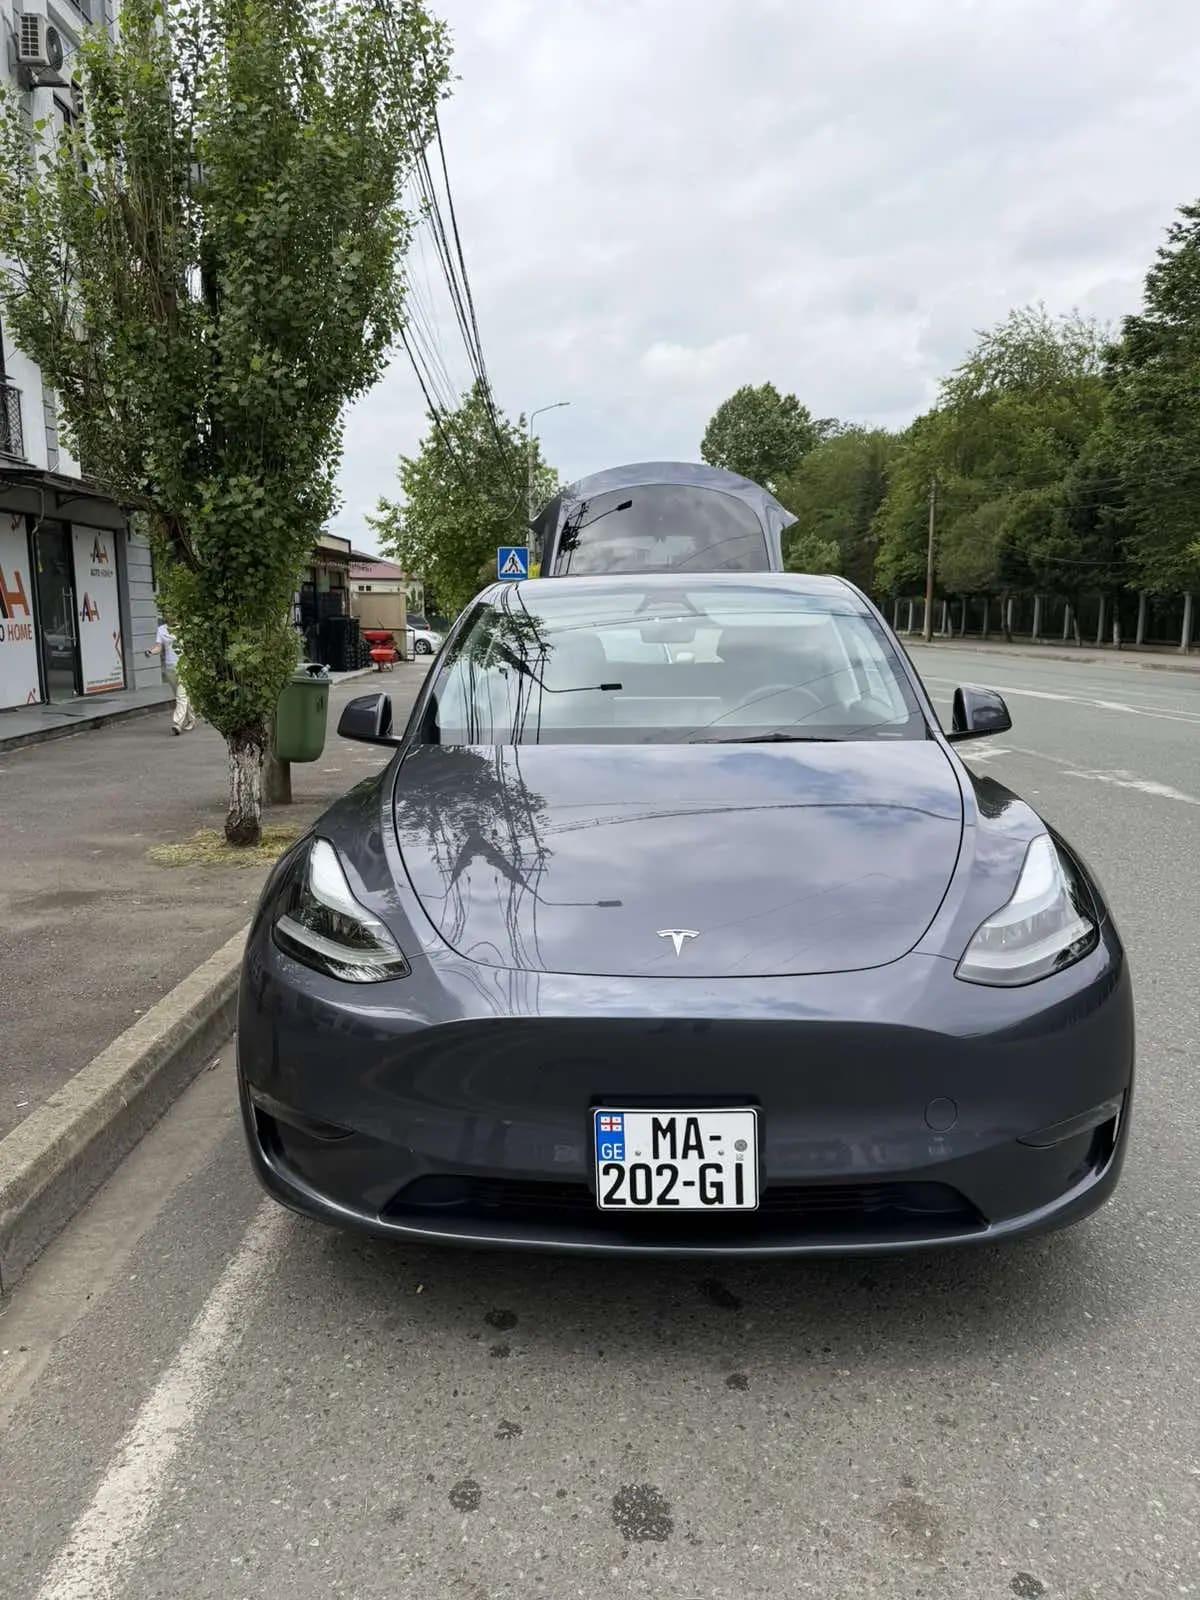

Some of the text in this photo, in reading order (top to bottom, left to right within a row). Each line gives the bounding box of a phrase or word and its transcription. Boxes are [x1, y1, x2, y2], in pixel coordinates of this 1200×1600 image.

[7, 623, 33, 641] HOME
[601, 1143, 623, 1160] GE
[602, 1162, 744, 1205] 202-GI
